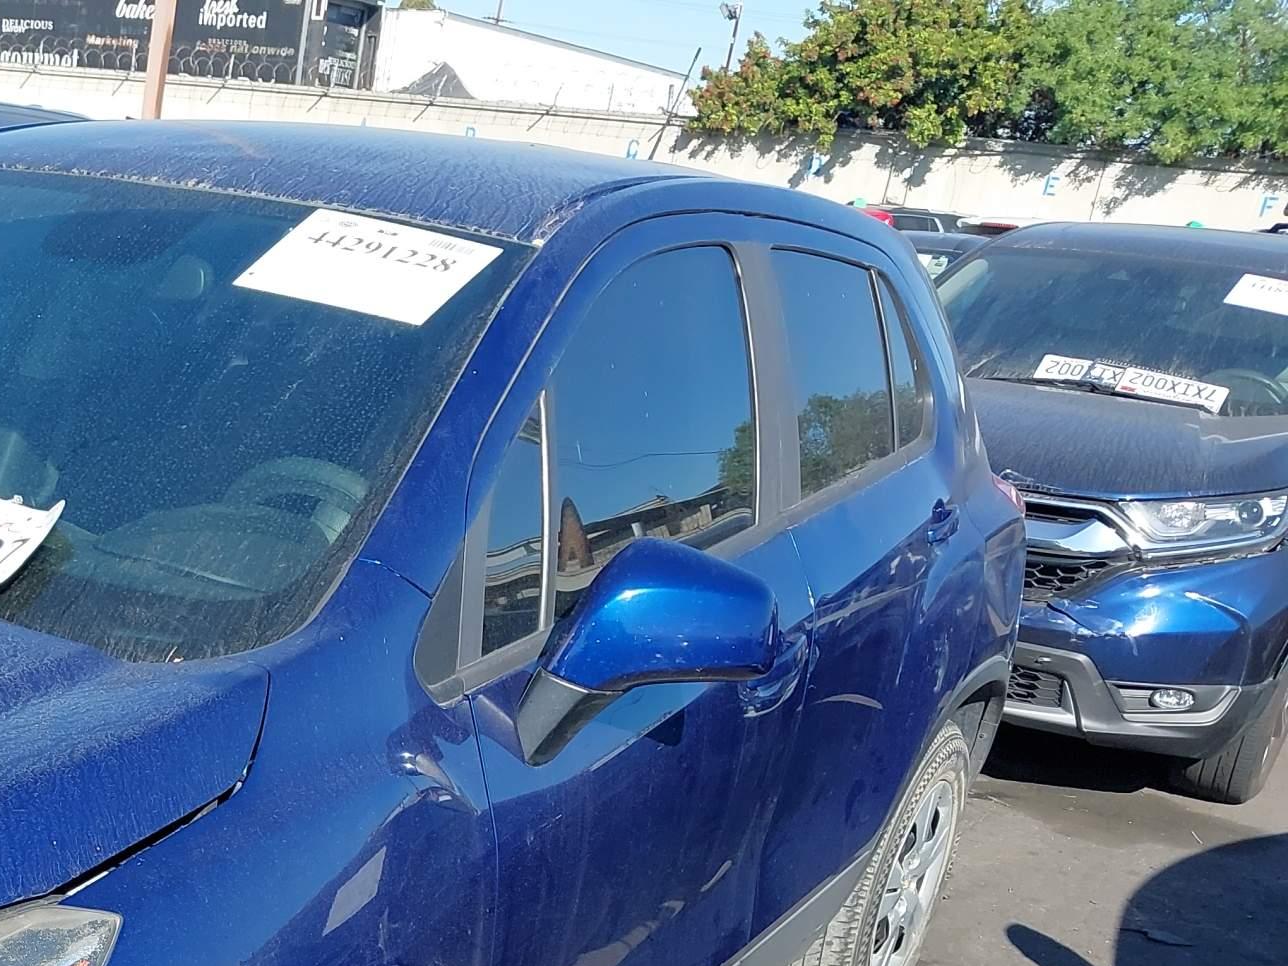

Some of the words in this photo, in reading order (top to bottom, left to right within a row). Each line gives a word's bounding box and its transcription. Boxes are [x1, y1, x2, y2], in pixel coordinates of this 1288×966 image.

[1, 18, 54, 30] DELICIOUS
[198, 9, 268, 30] imported
[1042, 175, 1061, 197] E
[1259, 195, 1280, 218] F
[307, 231, 457, 272] 44291228
